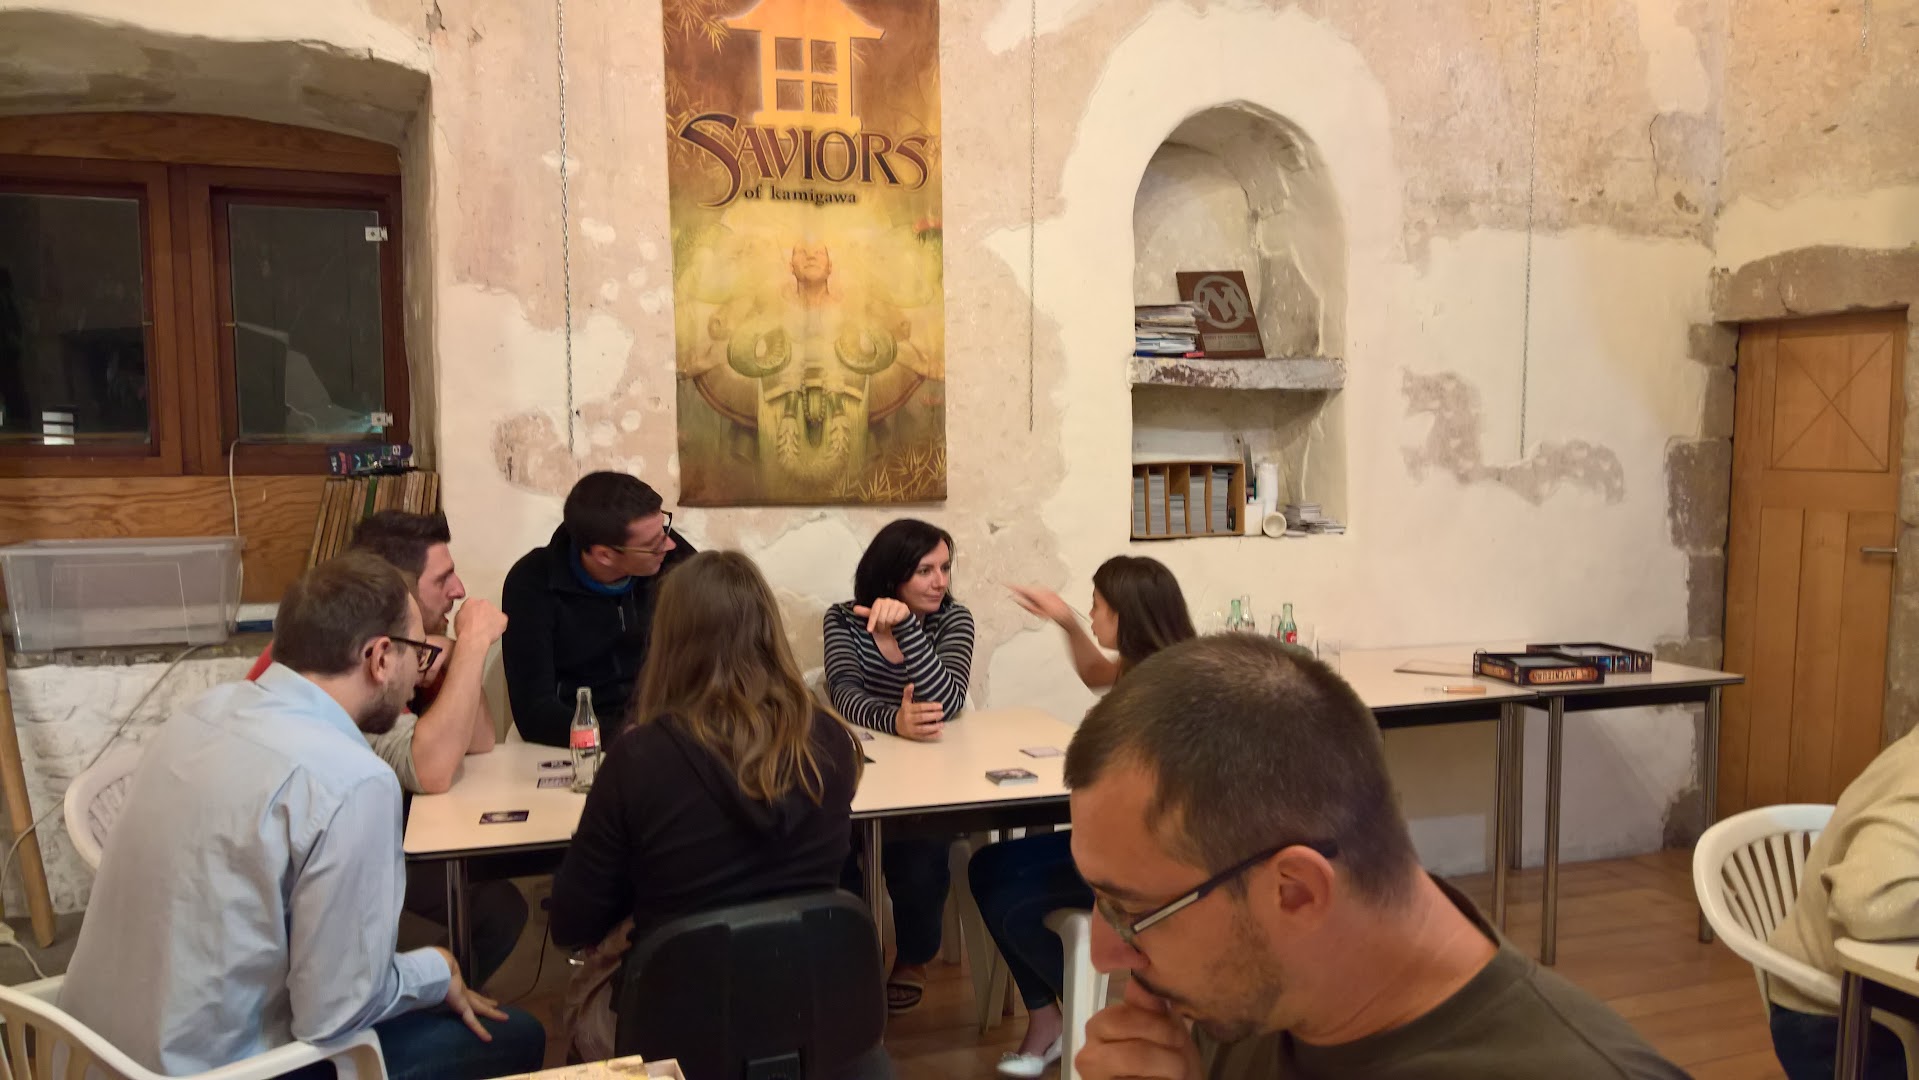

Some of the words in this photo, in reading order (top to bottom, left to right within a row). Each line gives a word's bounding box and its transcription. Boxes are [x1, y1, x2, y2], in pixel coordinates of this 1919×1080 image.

[679, 112, 929, 207] SAVIORS
[744, 184, 762, 199] of
[771, 185, 856, 207] kamigawa
